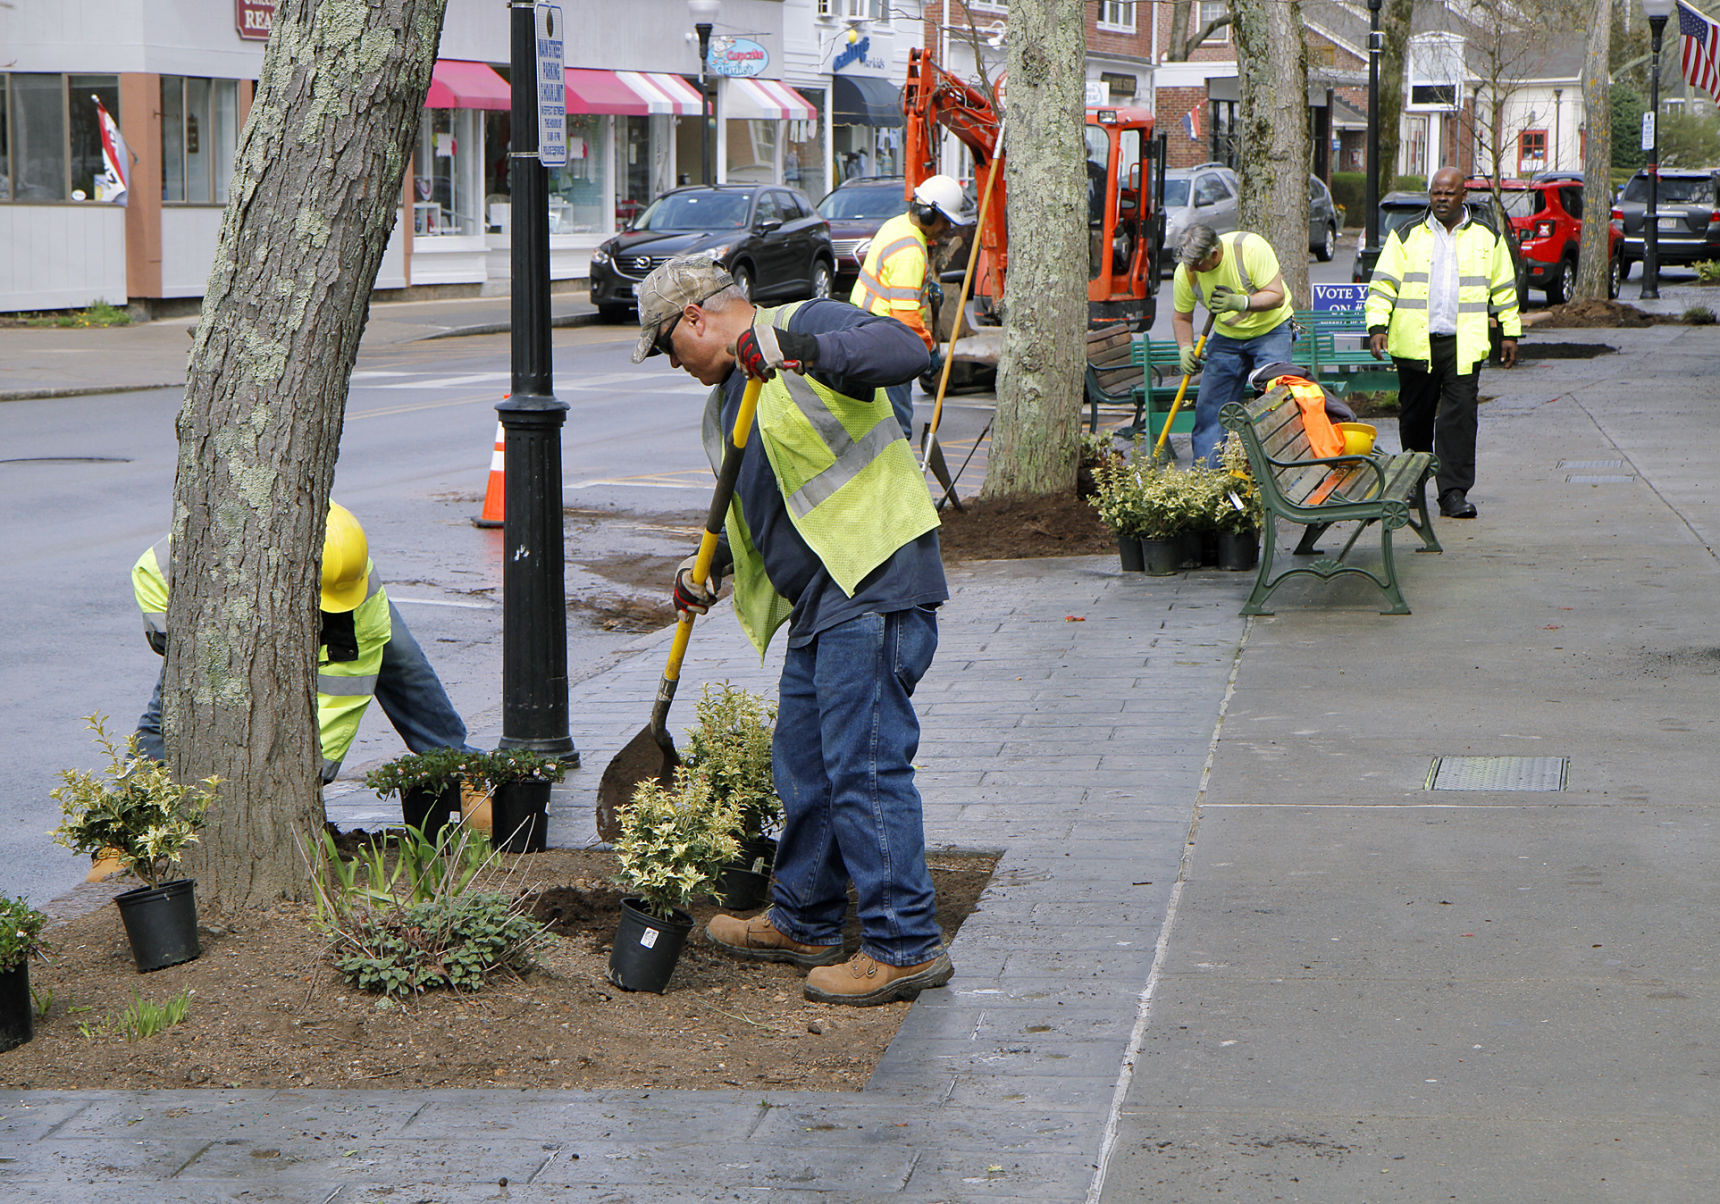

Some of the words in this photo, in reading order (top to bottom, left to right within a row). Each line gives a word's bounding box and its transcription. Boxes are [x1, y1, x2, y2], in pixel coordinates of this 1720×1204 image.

[244, 10, 273, 29] REA
[727, 49, 764, 64] Cupcake
[543, 61, 560, 80] PARKING
[1356, 286, 1368, 299] Y
